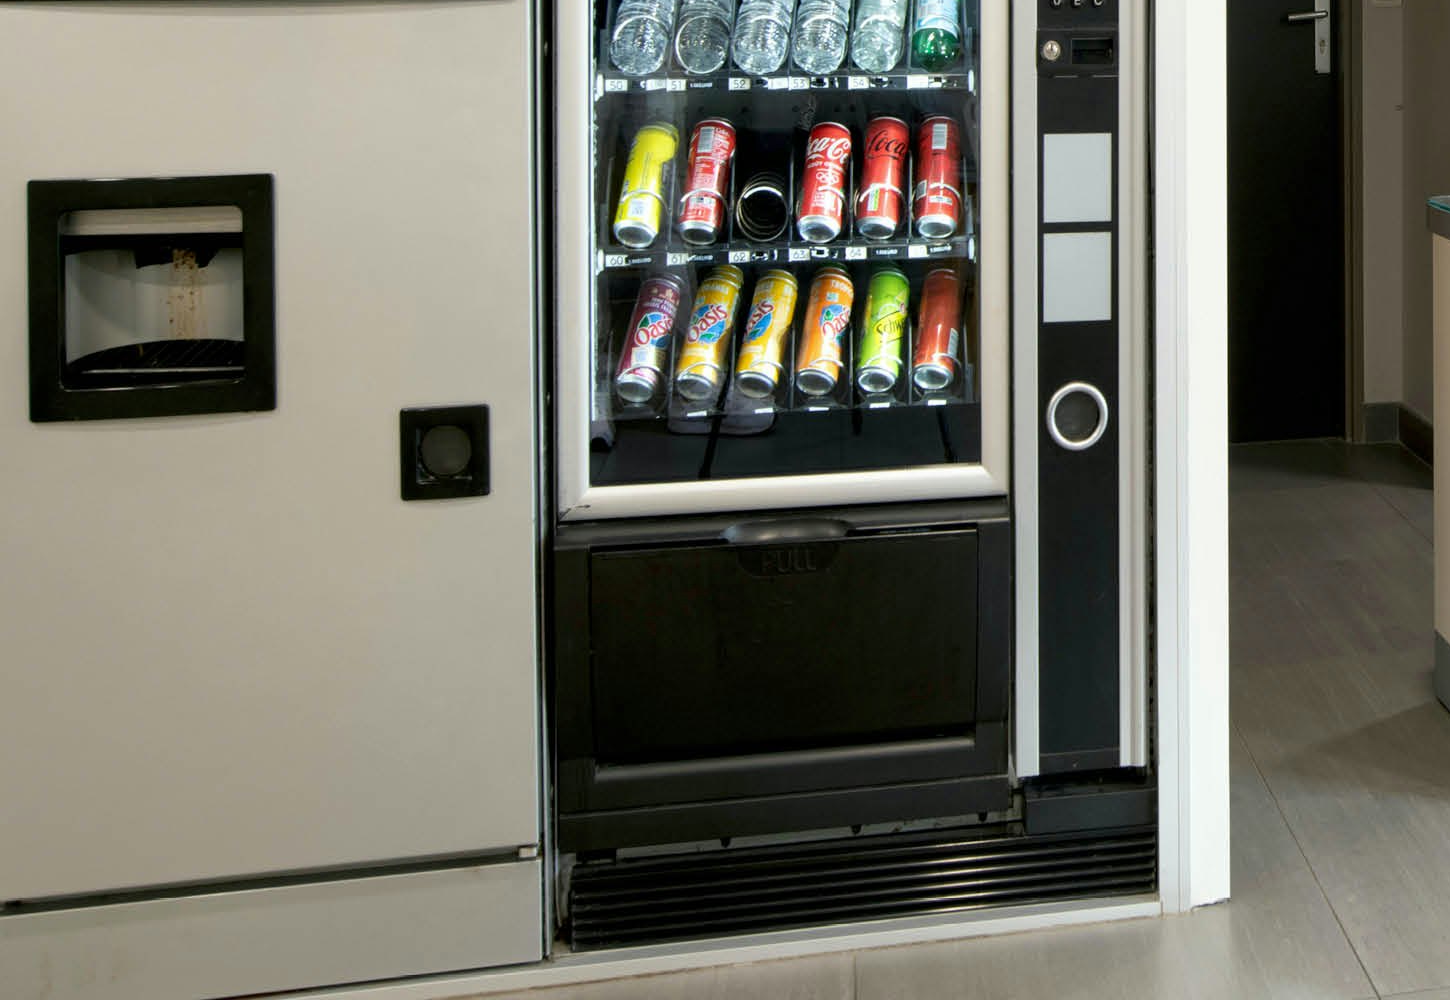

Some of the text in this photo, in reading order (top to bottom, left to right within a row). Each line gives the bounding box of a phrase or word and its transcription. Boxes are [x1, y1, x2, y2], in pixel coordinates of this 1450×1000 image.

[687, 304, 728, 343] Oasis
[746, 301, 776, 336] asis
[821, 306, 851, 340] Oasi
